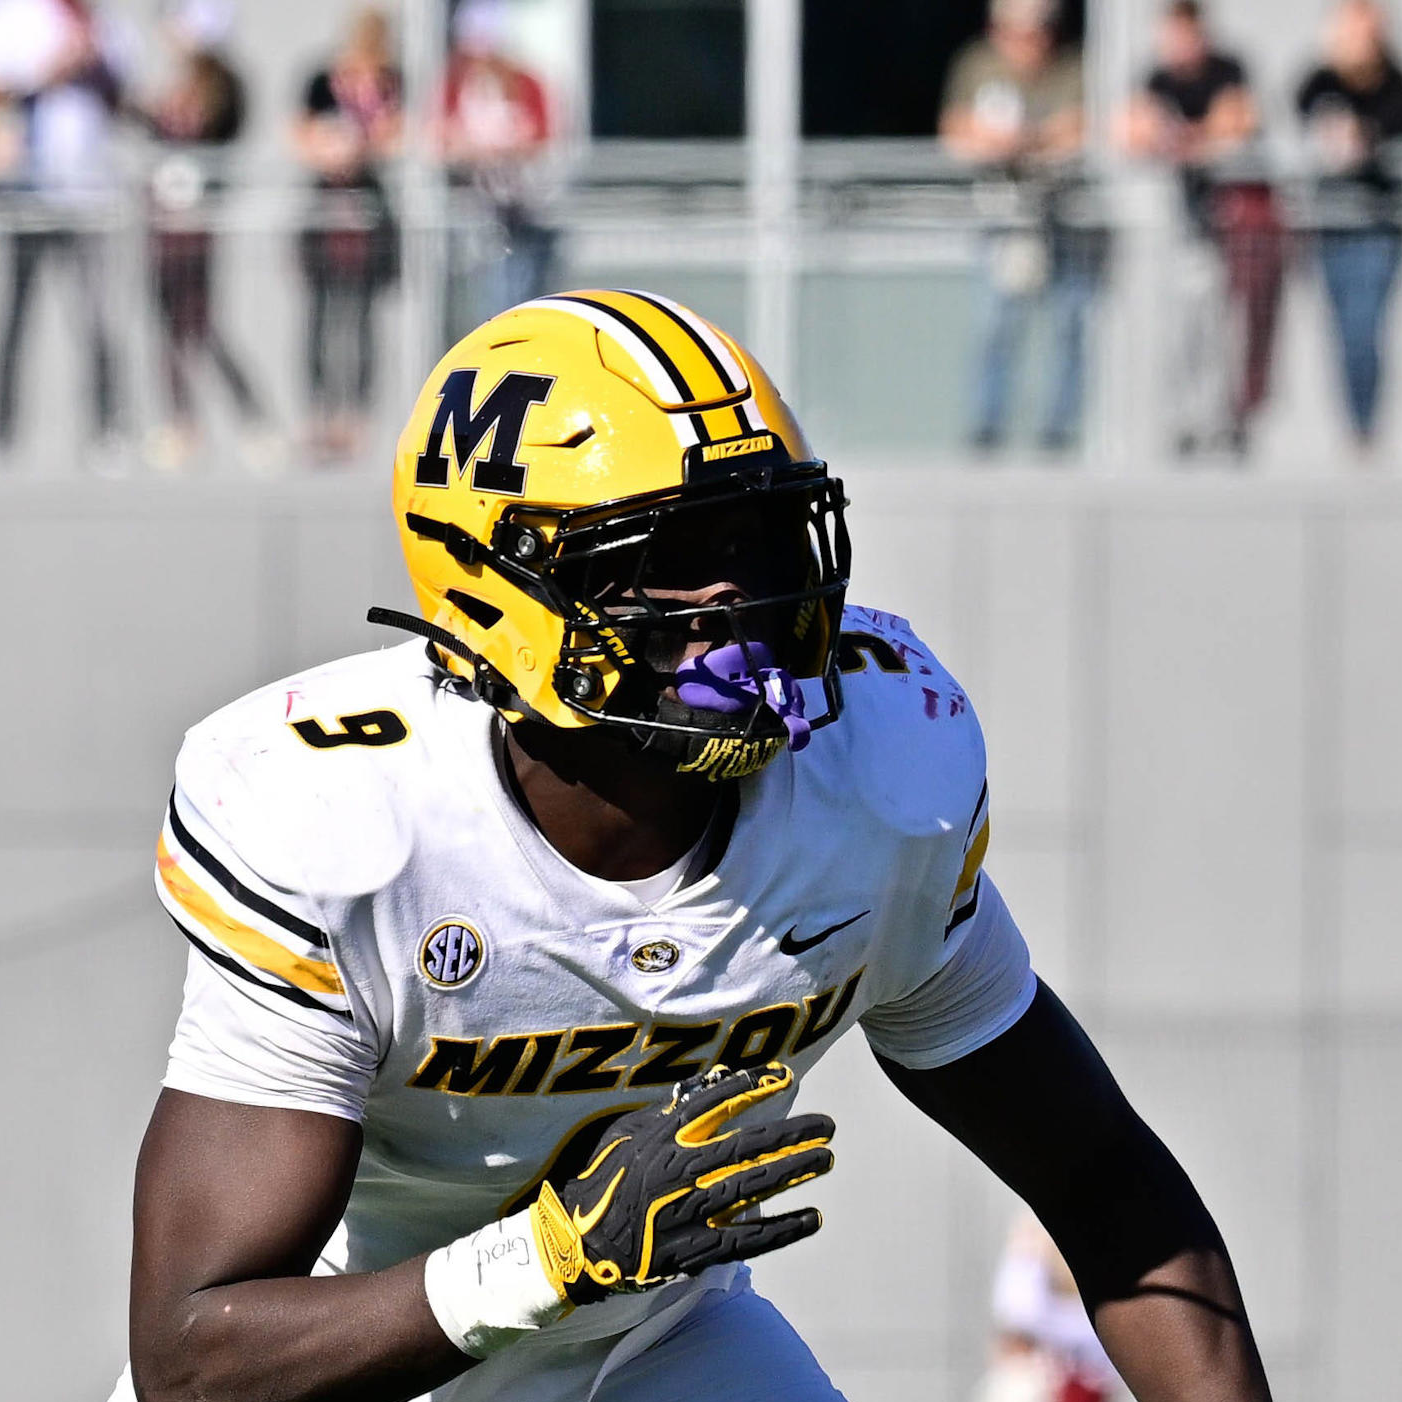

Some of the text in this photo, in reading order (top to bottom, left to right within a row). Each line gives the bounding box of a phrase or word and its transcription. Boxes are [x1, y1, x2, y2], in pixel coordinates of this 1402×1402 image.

[414, 367, 558, 498] M
[701, 434, 775, 463] MIZZOU
[285, 707, 412, 751] 9
[426, 926, 477, 981] SEC
[405, 964, 866, 1096] MIZZOU
